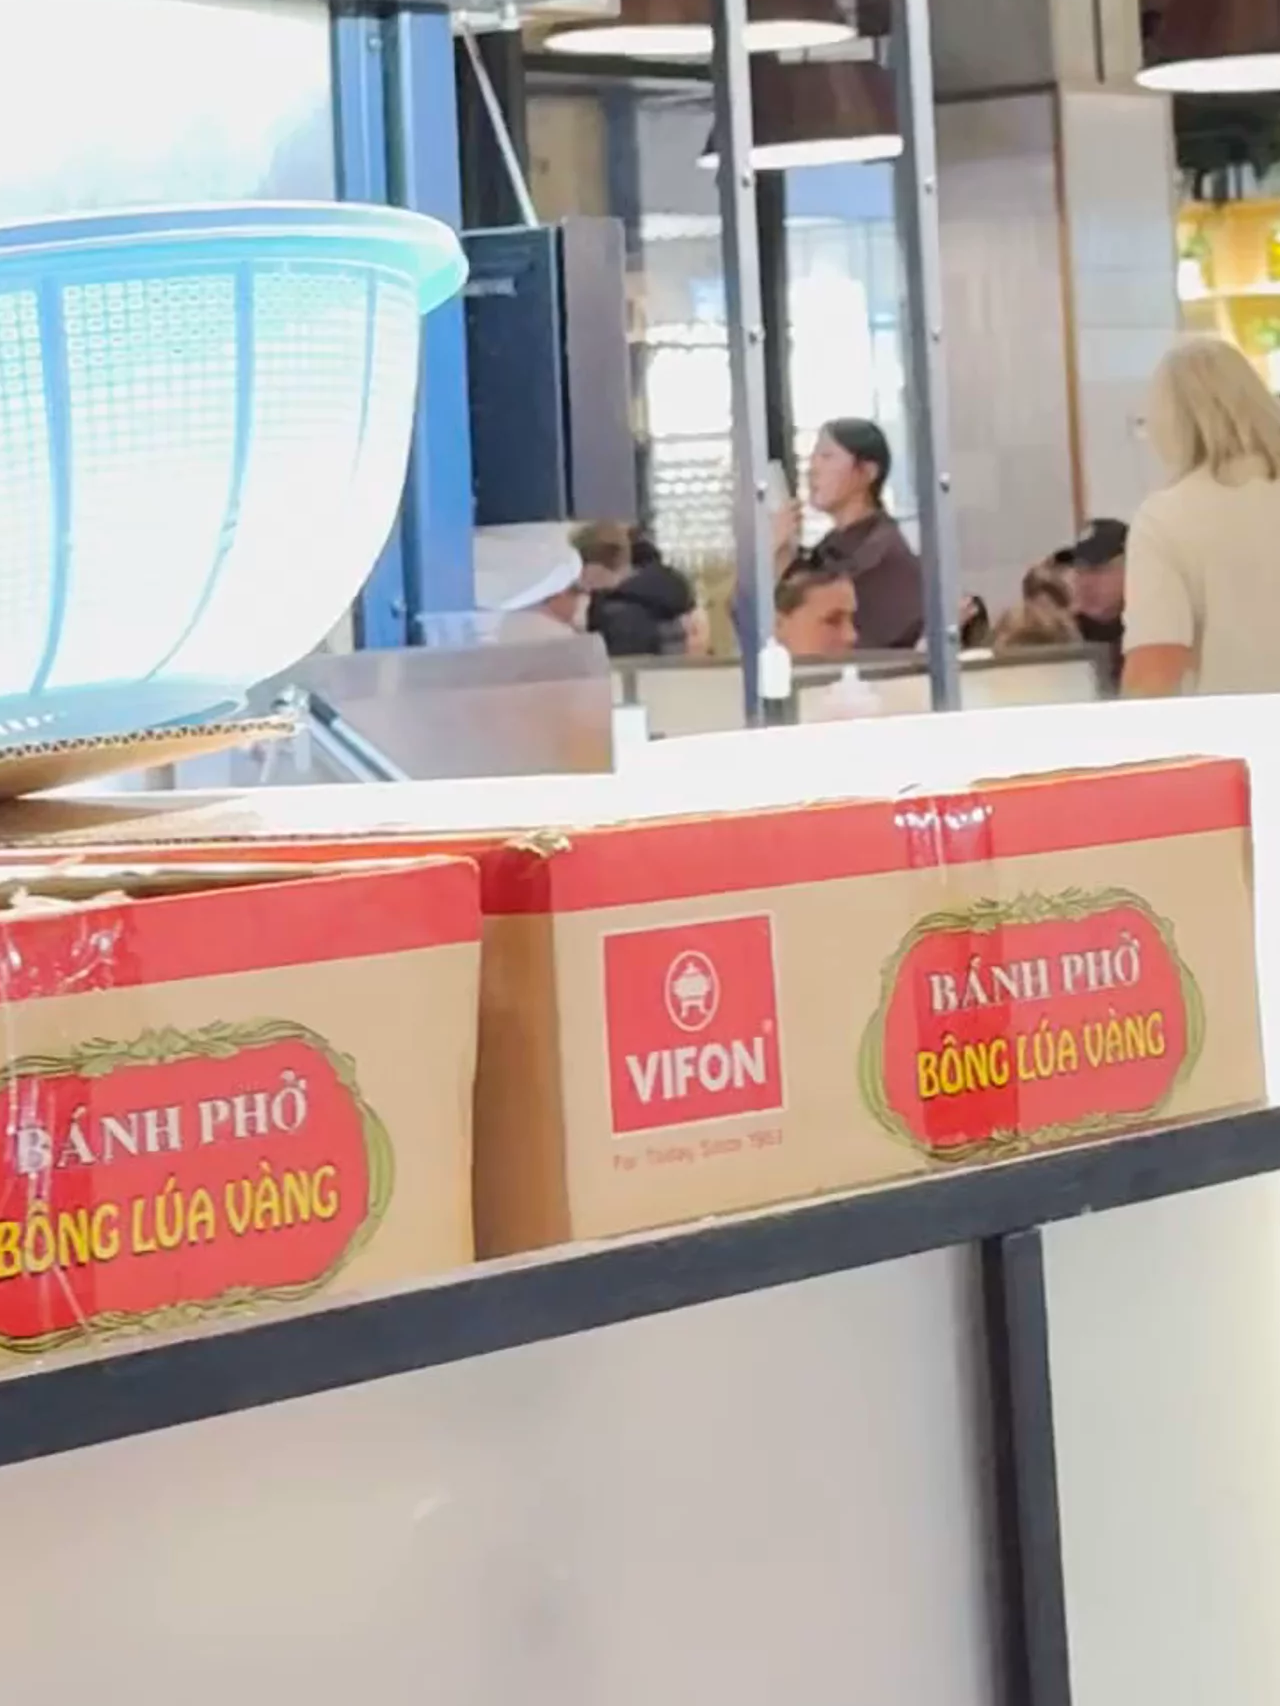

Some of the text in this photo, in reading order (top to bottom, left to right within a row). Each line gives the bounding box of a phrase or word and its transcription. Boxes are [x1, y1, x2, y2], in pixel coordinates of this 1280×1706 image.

[928, 931, 1141, 1017] BÁNH PHỞ
[625, 1036, 766, 1105] VIFON
[917, 1007, 1167, 1100] BÔNG LÚA VÀNG
[15, 1068, 308, 1174] BÁNH PHỞ
[130, 1173, 216, 1256] LÚA
[224, 1161, 341, 1237] VÀNG
